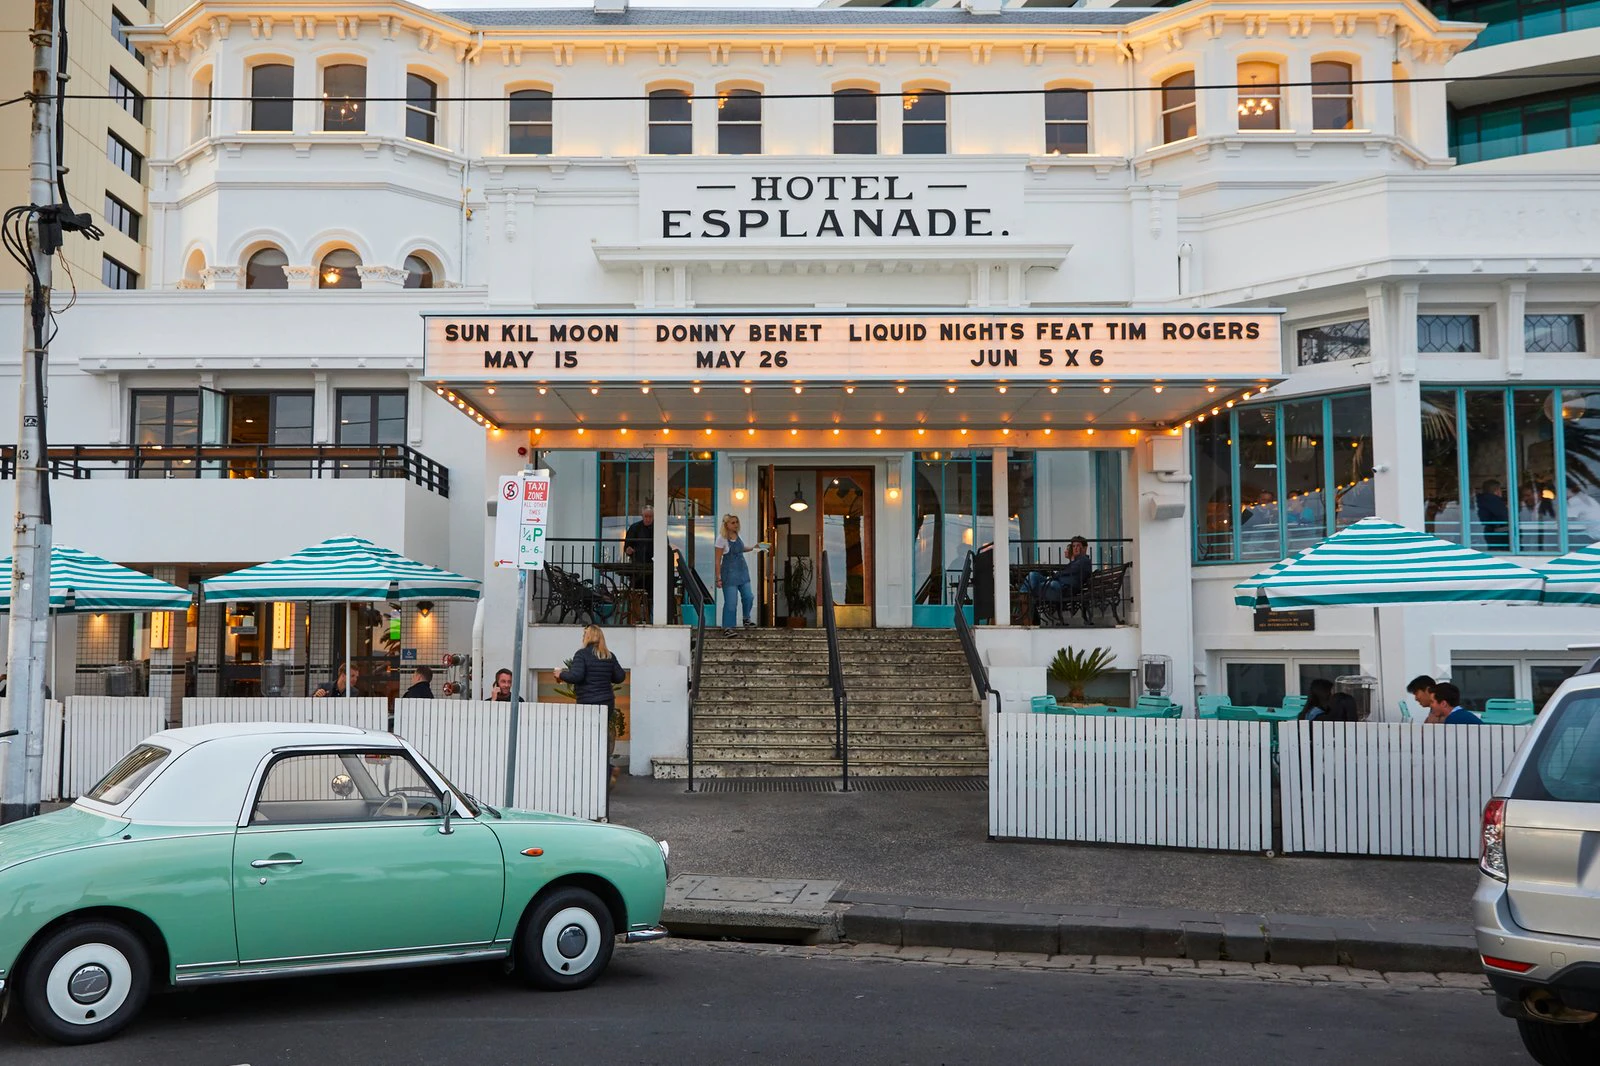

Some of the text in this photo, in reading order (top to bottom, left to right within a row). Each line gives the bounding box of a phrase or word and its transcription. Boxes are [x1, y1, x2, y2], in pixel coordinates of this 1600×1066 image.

[751, 176, 913, 201] HOTEL
[661, 208, 1010, 239] ESPLANADE.
[445, 324, 619, 342] SUN KIL MOON
[656, 324, 822, 342] DONNY BENET
[849, 322, 1260, 342] LIQUID NIGHTS FEAT TIM ROGERS
[484, 350, 578, 369] MAY 15
[696, 350, 788, 369] MAY 26
[970, 348, 1104, 367] JUN 5 X 6
[527, 491, 544, 500] ZONE
[528, 482, 546, 491] TAXI
